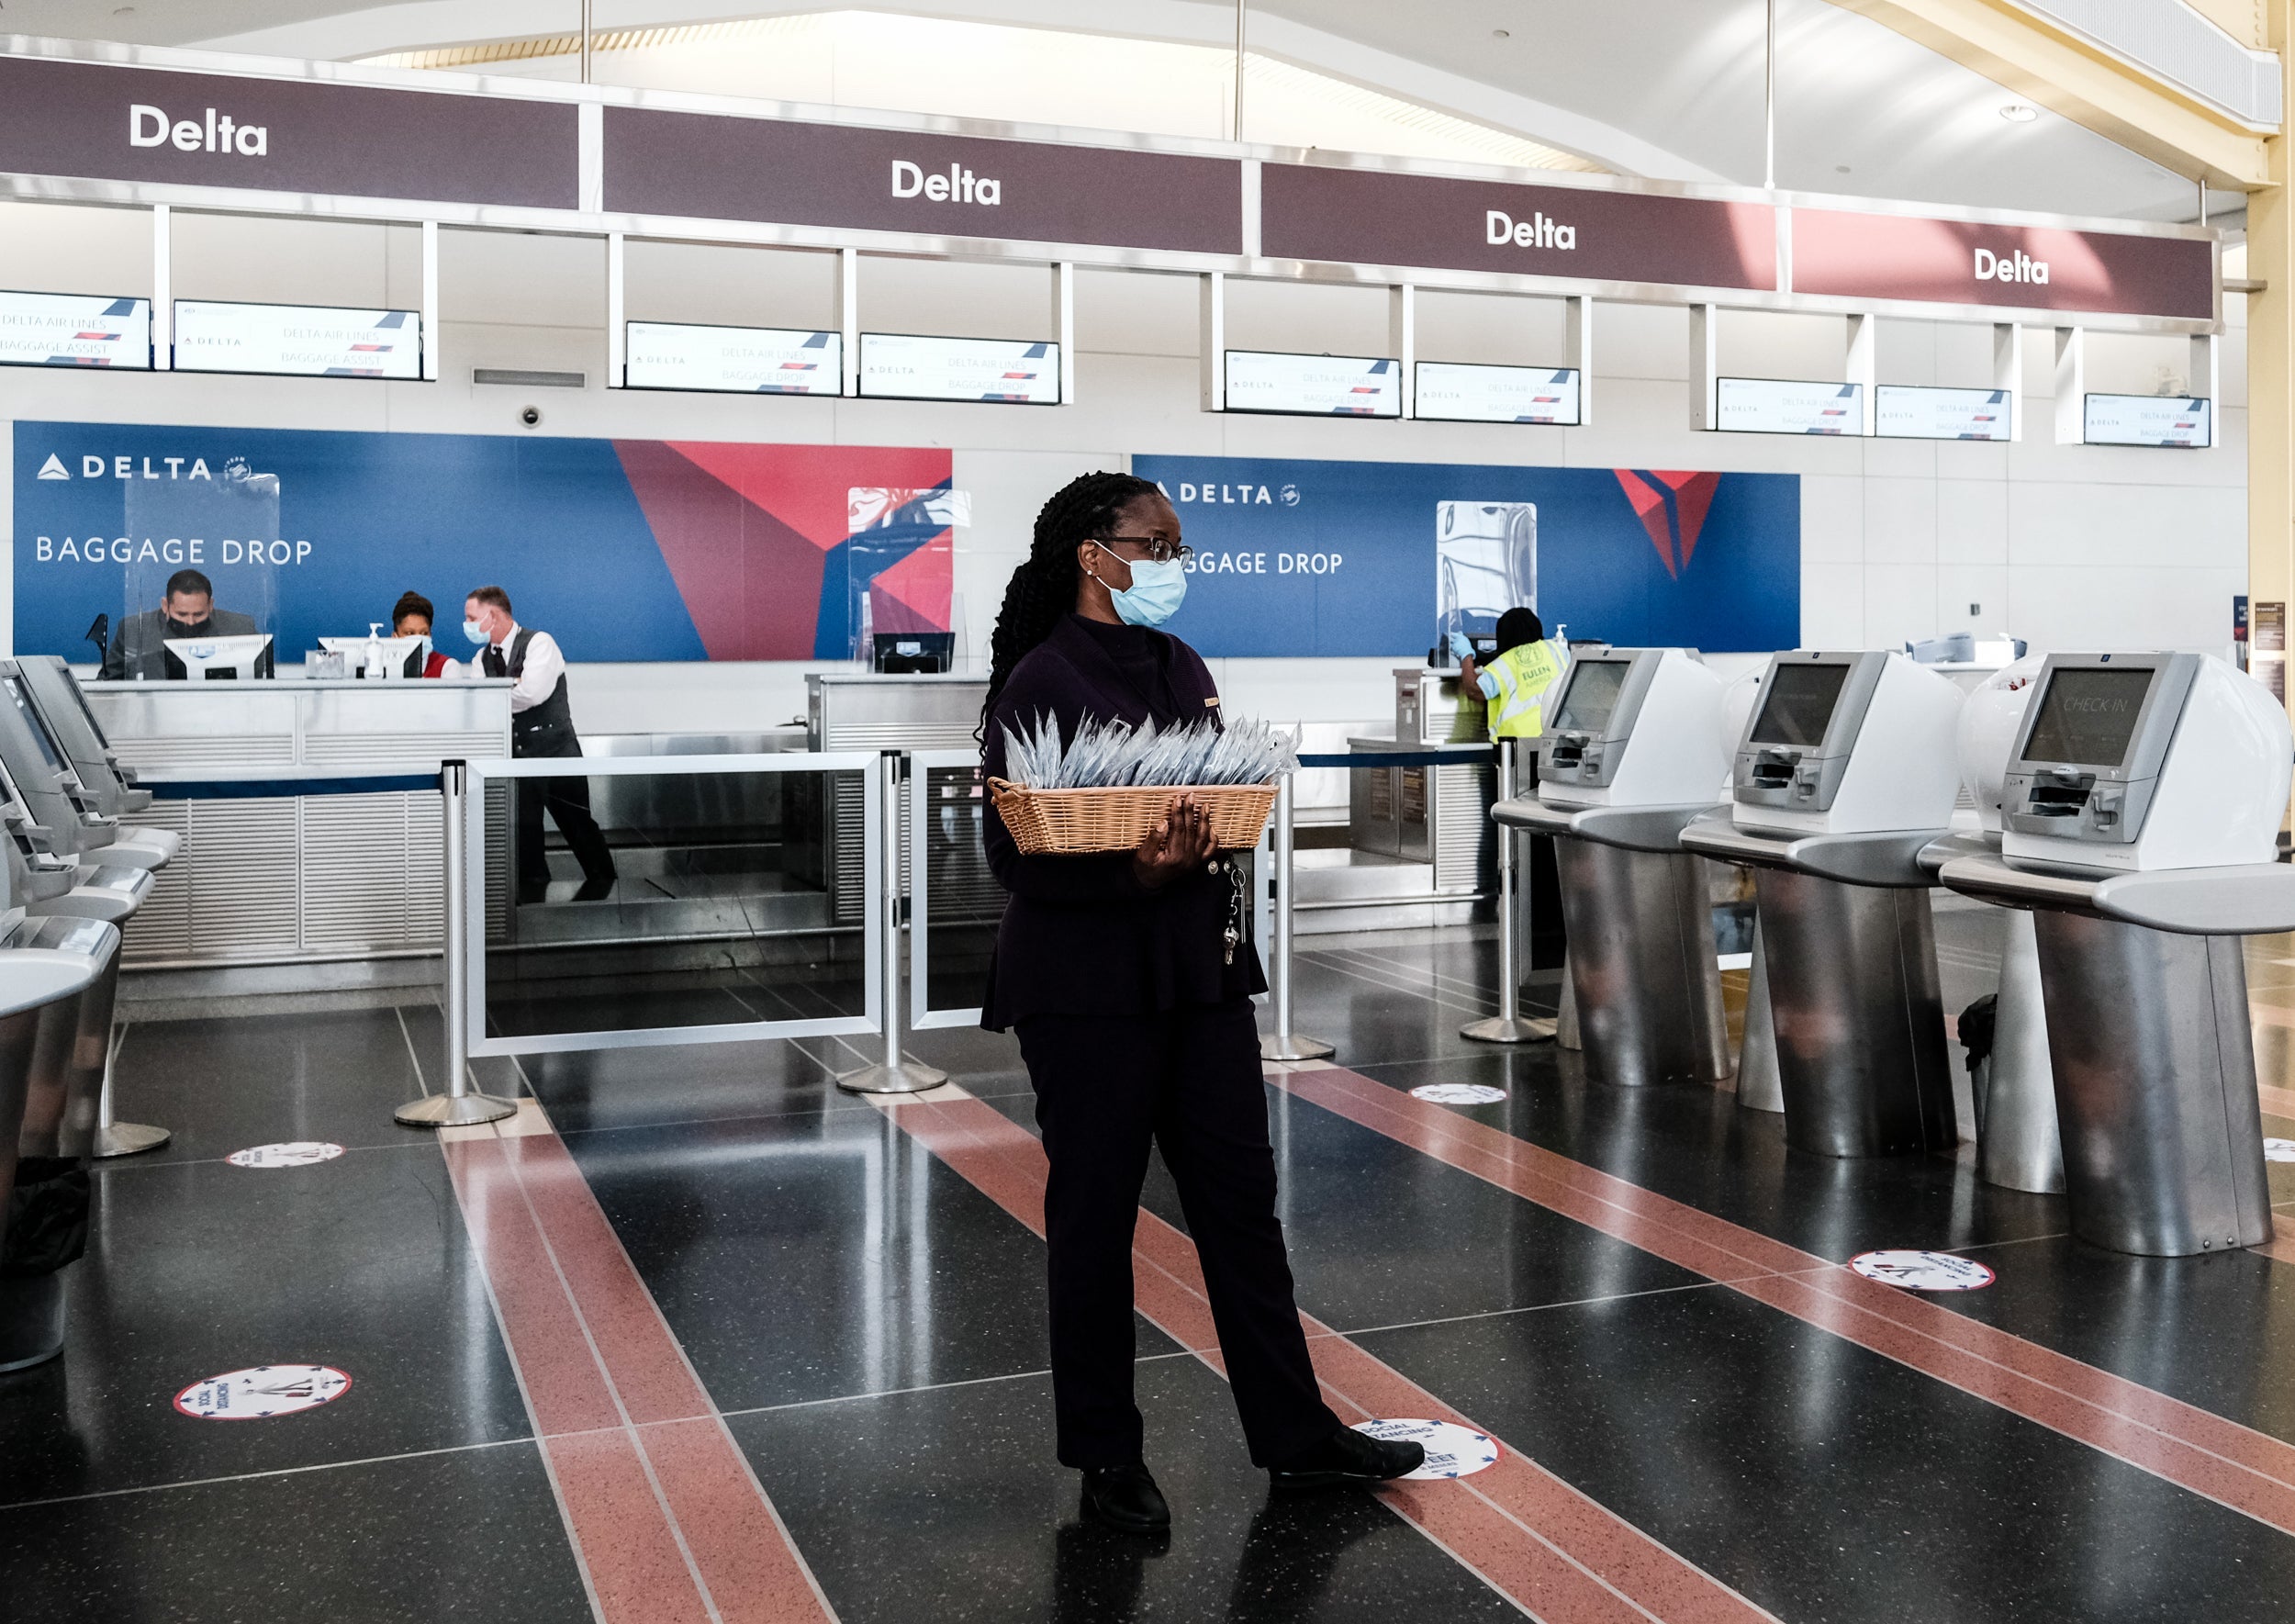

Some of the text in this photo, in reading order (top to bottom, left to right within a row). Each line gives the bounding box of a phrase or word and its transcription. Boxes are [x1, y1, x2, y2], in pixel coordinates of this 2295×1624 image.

[130, 104, 267, 156] Delta
[891, 160, 1001, 206] Delta
[1486, 210, 1575, 250] Delta
[1975, 248, 2049, 285] Delta
[3, 315, 106, 330] DELTA AIR LINES
[197, 337, 241, 346] DELTA
[284, 329, 380, 342] DELTA AIR LINES
[0, 341, 108, 353] BAGGAGE ASSIST
[282, 353, 380, 365] BAGGAGE ASSIST
[647, 356, 685, 364] DELTA
[722, 348, 805, 360] DELTA AIR LINES
[948, 358, 1026, 370] DELTA AIR LINES
[722, 369, 805, 383] BAGGAGE DROP
[879, 366, 914, 375] DELTA
[948, 379, 1025, 391] BAGGAGE DROP
[1304, 374, 1371, 386] DELTA AIR LINES
[1304, 394, 1371, 405] BAGGAGE DROP
[83, 455, 212, 480] DELTA
[1180, 483, 1272, 505] DELTA
[37, 536, 312, 566] BAGGAGE DROP
[1184, 552, 1343, 575] GGAGE DROP
[1361, 1423, 1411, 1434] SOCIAL
[1372, 1427, 1434, 1439] TANCING
[1424, 1454, 1459, 1464] EET
